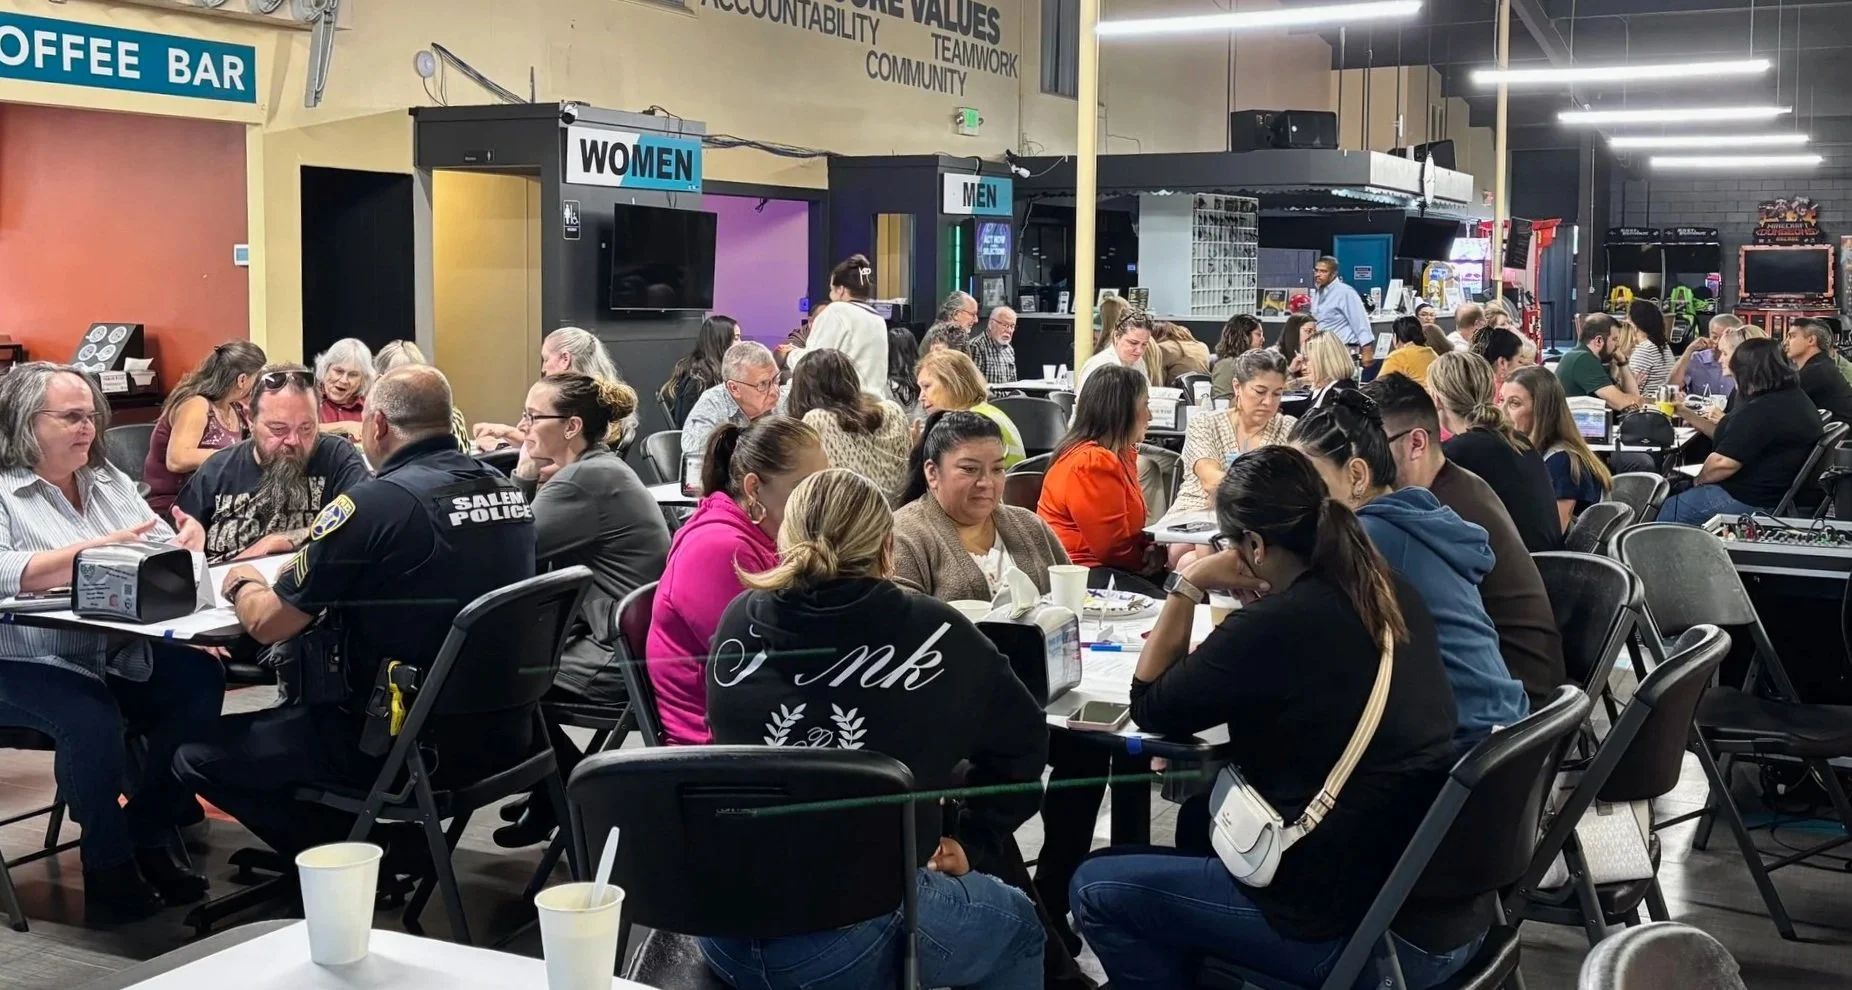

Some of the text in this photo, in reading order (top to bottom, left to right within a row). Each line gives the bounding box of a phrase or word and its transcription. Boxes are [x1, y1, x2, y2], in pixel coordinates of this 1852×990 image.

[910, 0, 1001, 45] VALUES
[168, 47, 245, 91] BAR
[866, 50, 967, 97] COMMUNITY
[931, 32, 1018, 78] TEAMWORK
[579, 138, 693, 182] WOMEN
[962, 182, 997, 208] MEN
[448, 504, 533, 527] POLICE
[452, 491, 525, 511] SALEM
